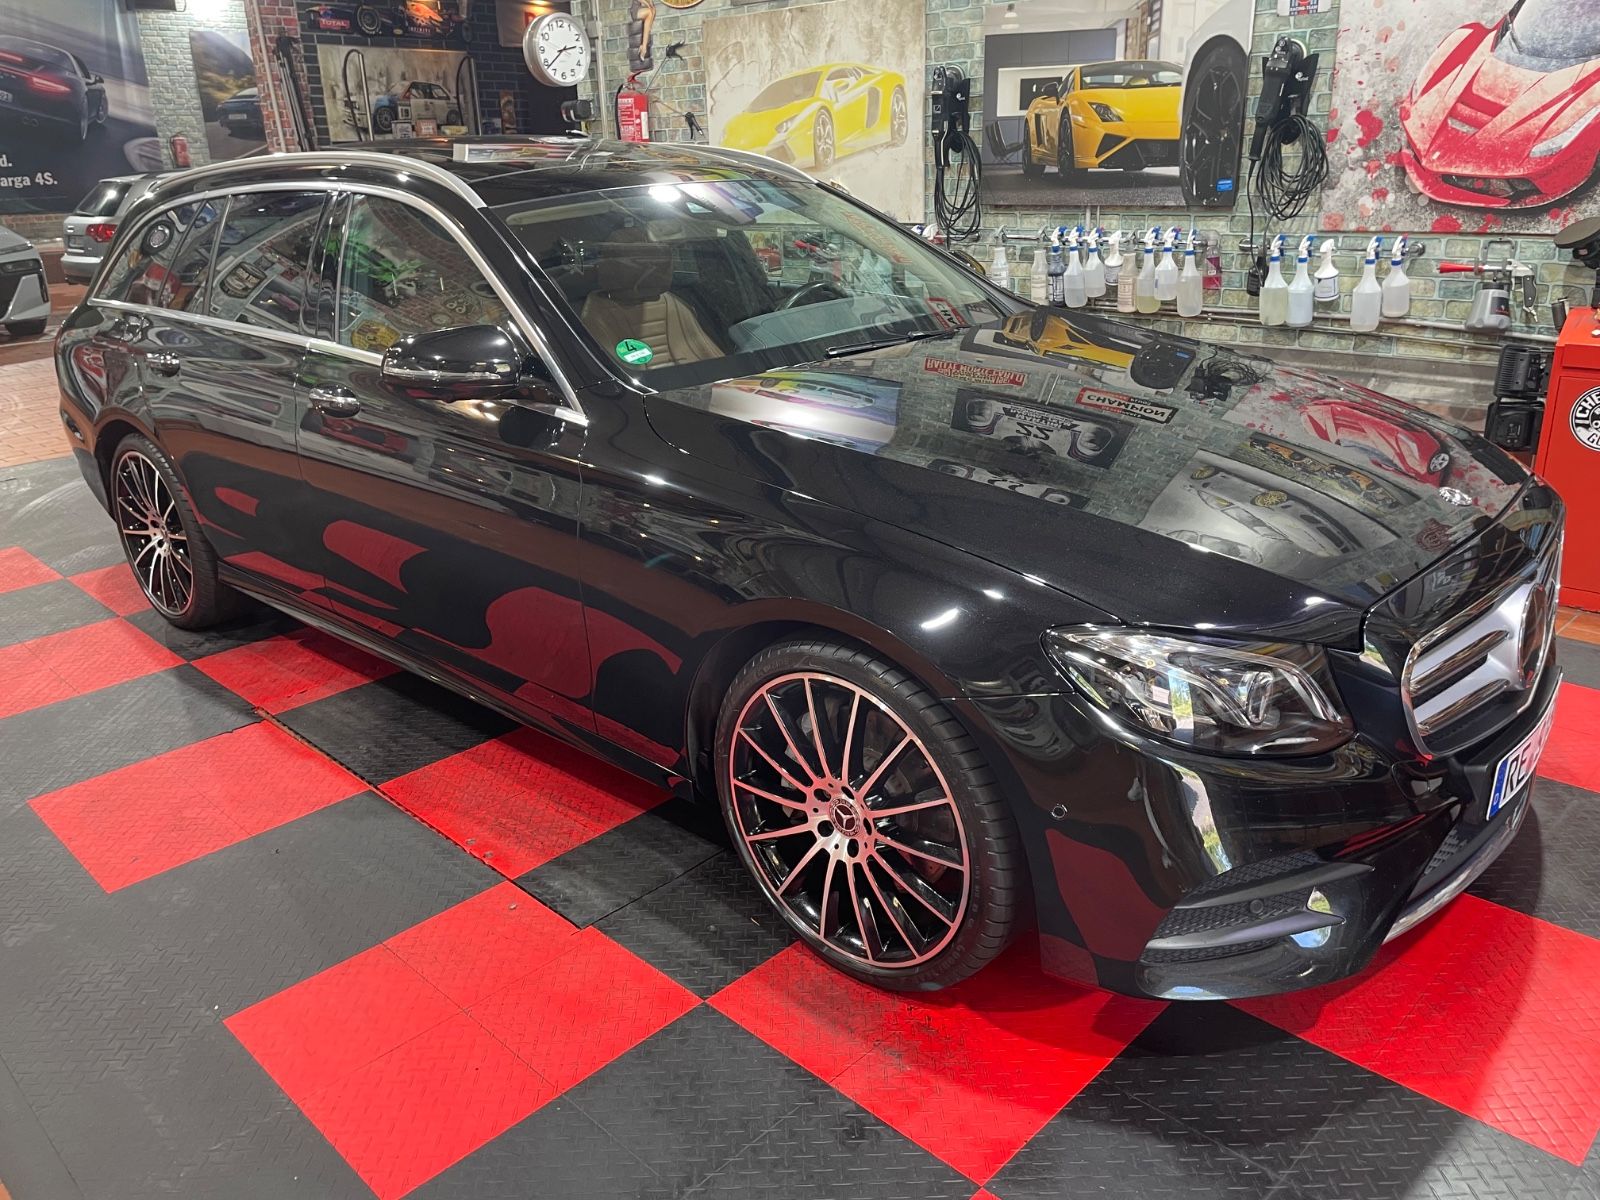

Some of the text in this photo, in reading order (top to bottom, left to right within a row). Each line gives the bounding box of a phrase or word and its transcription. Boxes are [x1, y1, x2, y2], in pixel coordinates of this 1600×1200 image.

[321, 18, 347, 27] TOTAL
[556, 20, 564, 28] 12
[547, 23, 554, 31] 11
[541, 32, 550, 41] 10
[574, 33, 581, 41] 2
[539, 46, 545, 54] 9
[543, 58, 549, 66] 8
[551, 68, 557, 76] 7
[561, 72, 567, 80] 6
[35, 172, 58, 186] 4S.
[624, 341, 637, 351] 4
